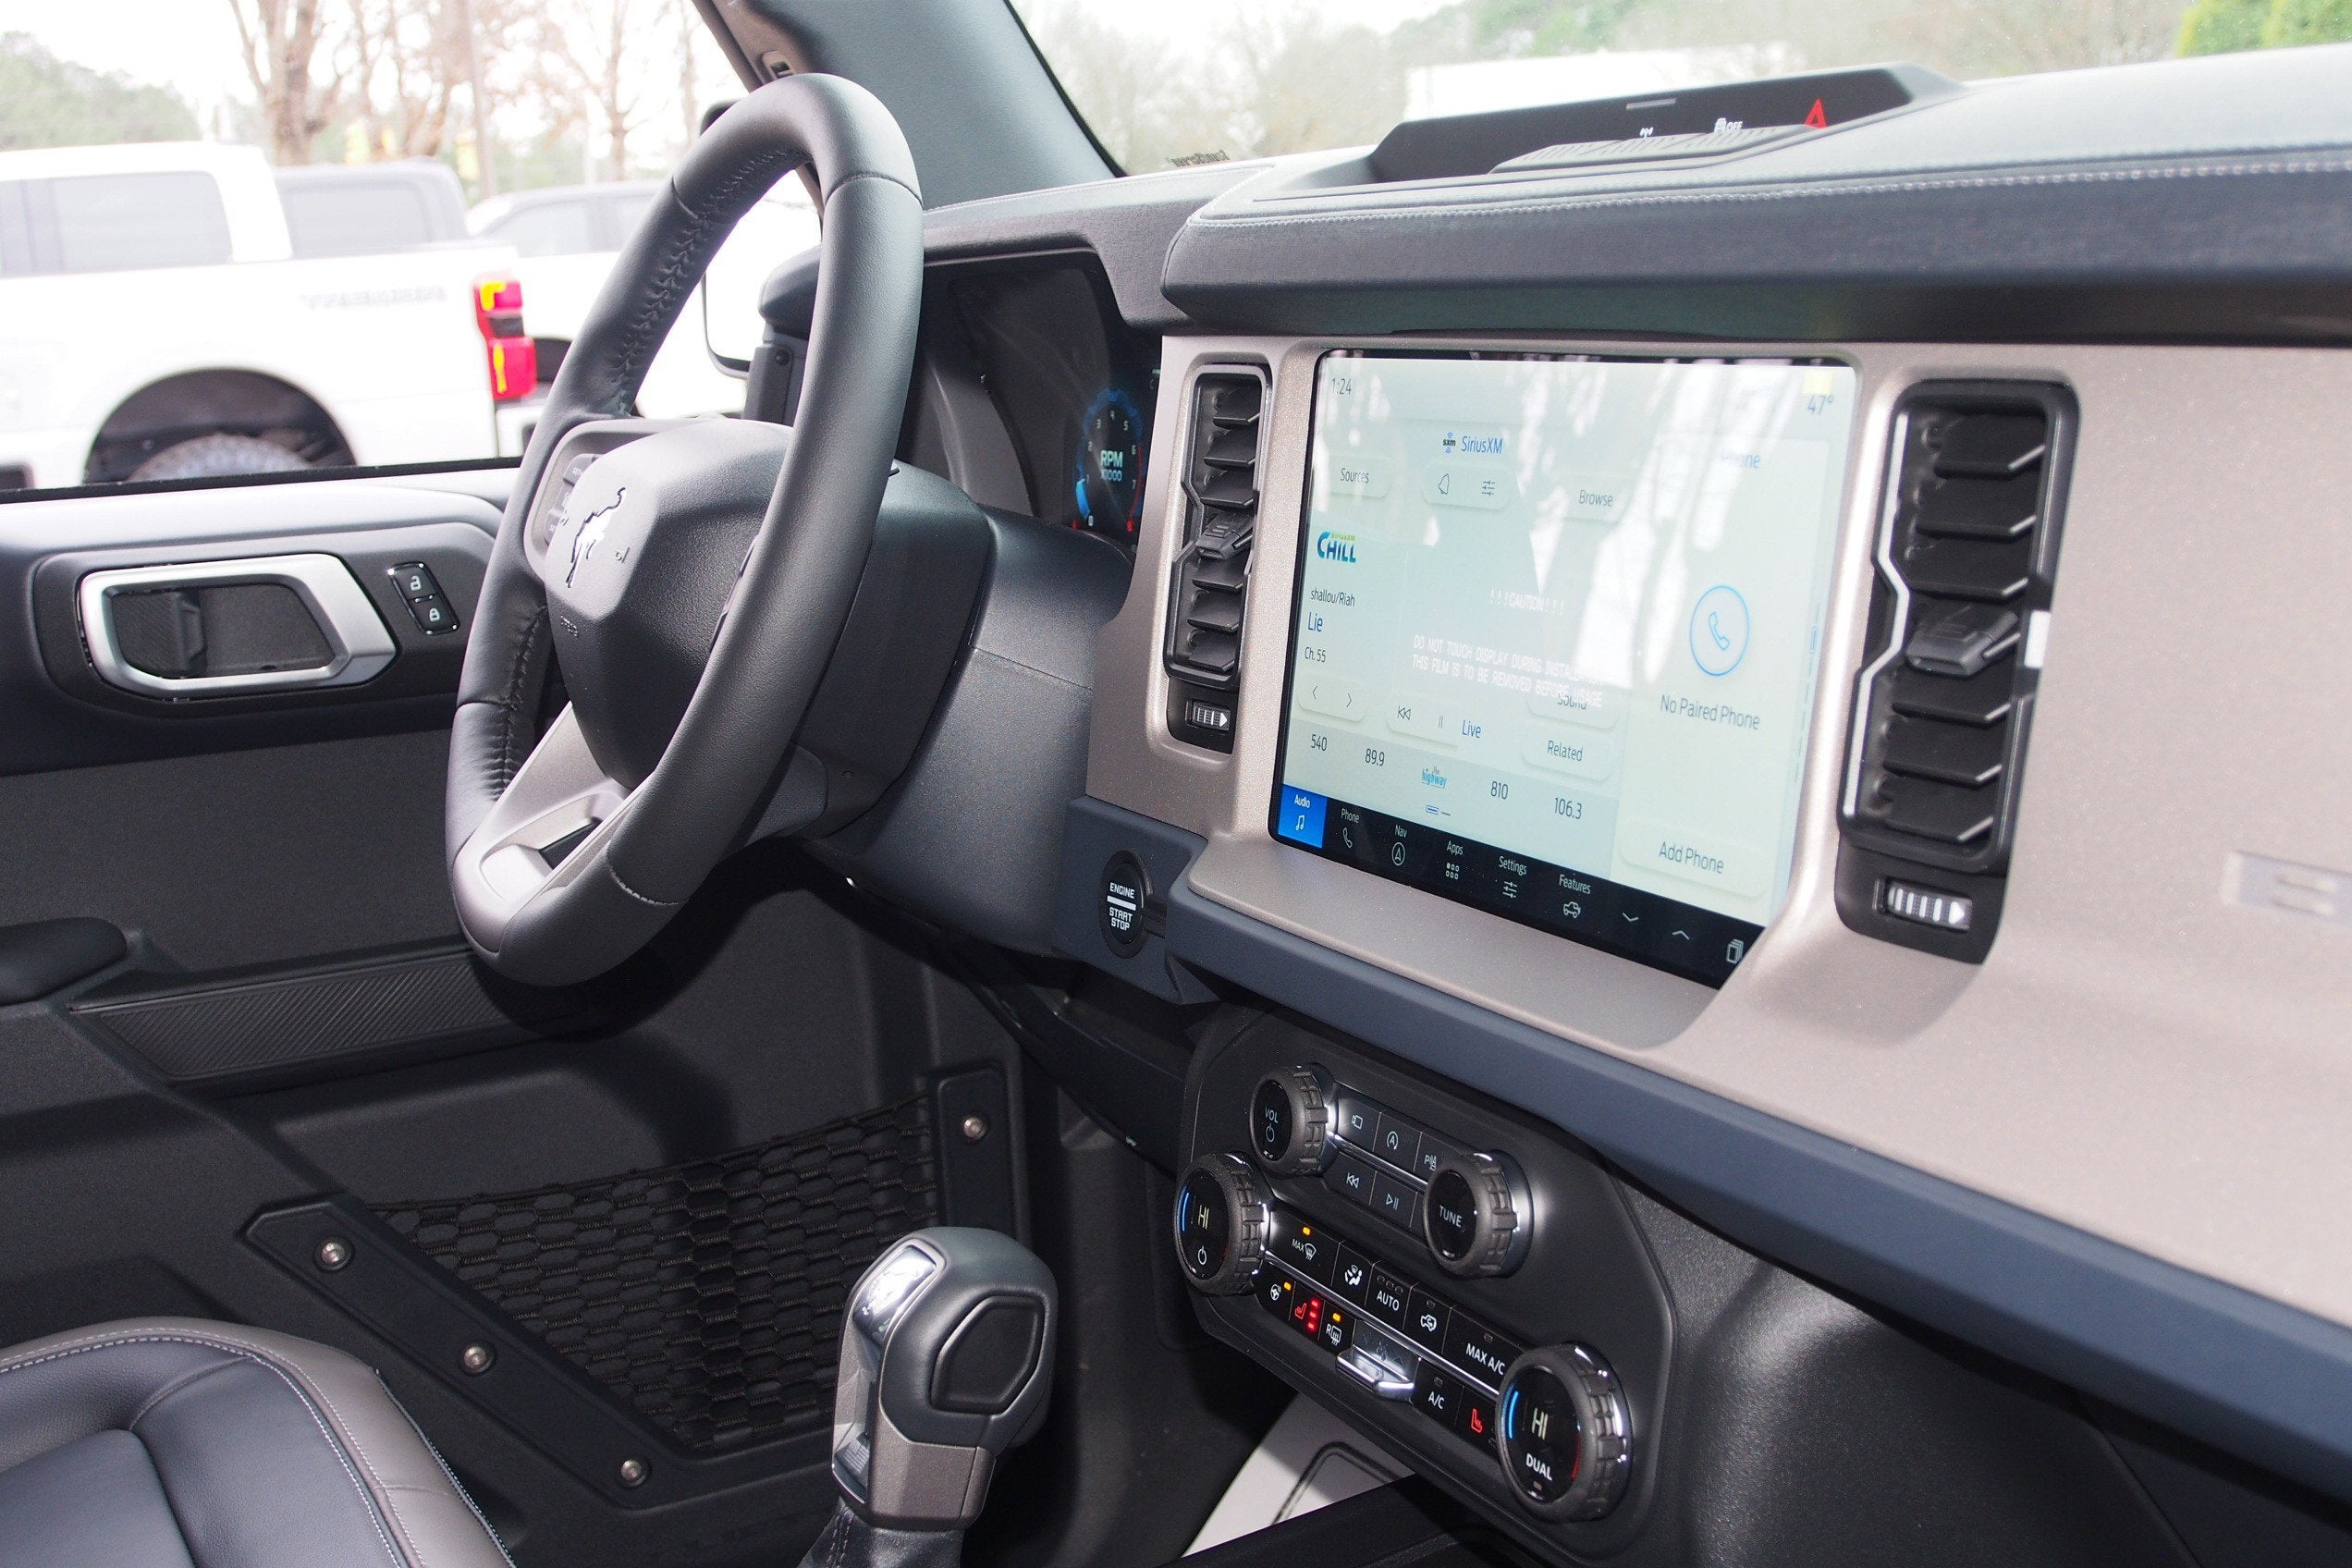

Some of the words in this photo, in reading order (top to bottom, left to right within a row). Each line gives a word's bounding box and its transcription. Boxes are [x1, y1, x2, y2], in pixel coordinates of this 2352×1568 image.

[1726, 121, 1744, 131] OFF
[1331, 377, 1352, 396] 1:24
[1461, 435, 1503, 455] SiriusXM
[1100, 449, 1123, 468] RPM
[1340, 468, 1369, 484] Sources
[1579, 489, 1614, 508] Browse
[1317, 531, 1357, 564] CHILL
[1310, 587, 1355, 607] shallou/Riah
[1307, 611, 1323, 632] Lie
[1317, 648, 1327, 663] 55
[1414, 634, 1425, 649] DO
[1427, 638, 1444, 654] NOT
[1447, 641, 1472, 658] TOUCH
[1476, 646, 1509, 666] DISPLAY
[1512, 654, 1541, 674] DURING
[1412, 654, 1428, 671] THIS
[1432, 658, 1449, 675] FILM
[1452, 663, 1460, 678] IS
[1464, 665, 1475, 680] TO
[1477, 668, 1488, 684] BE
[1492, 671, 1532, 692] REMOVED
[1660, 693, 1676, 714] No
[1680, 697, 1719, 721] Paired
[1720, 705, 1760, 729] Phone
[1462, 719, 1482, 739] Live
[1311, 734, 1328, 752] 540
[1547, 740, 1583, 762] Related
[1365, 748, 1385, 766] 89.9
[1421, 768, 1448, 789] highway
[1490, 780, 1509, 800] 810
[1293, 793, 1311, 809] Audio
[1554, 797, 1582, 820] 106.3
[1341, 808, 1360, 824] Phone
[1394, 825, 1408, 839] Nav
[1446, 840, 1464, 857] Apps
[1659, 841, 1684, 863] Add
[1685, 848, 1724, 874] Phone
[1499, 856, 1527, 876] Settings
[1109, 882, 1135, 900] ENGINE
[1559, 874, 1591, 895] Features
[1109, 906, 1133, 924] START
[1111, 918, 1131, 931] STOP
[1265, 1107, 1279, 1123] VOL
[1197, 1204, 1210, 1230] HI
[1439, 1204, 1463, 1228] TUNE
[1292, 1238, 1305, 1254] MAX
[1377, 1290, 1400, 1312] AUTO
[1465, 1342, 1487, 1366] MAX
[1488, 1356, 1506, 1376] A/C
[1428, 1390, 1445, 1410] A/C
[1531, 1407, 1549, 1440] HI
[1526, 1452, 1553, 1481] DUAL
